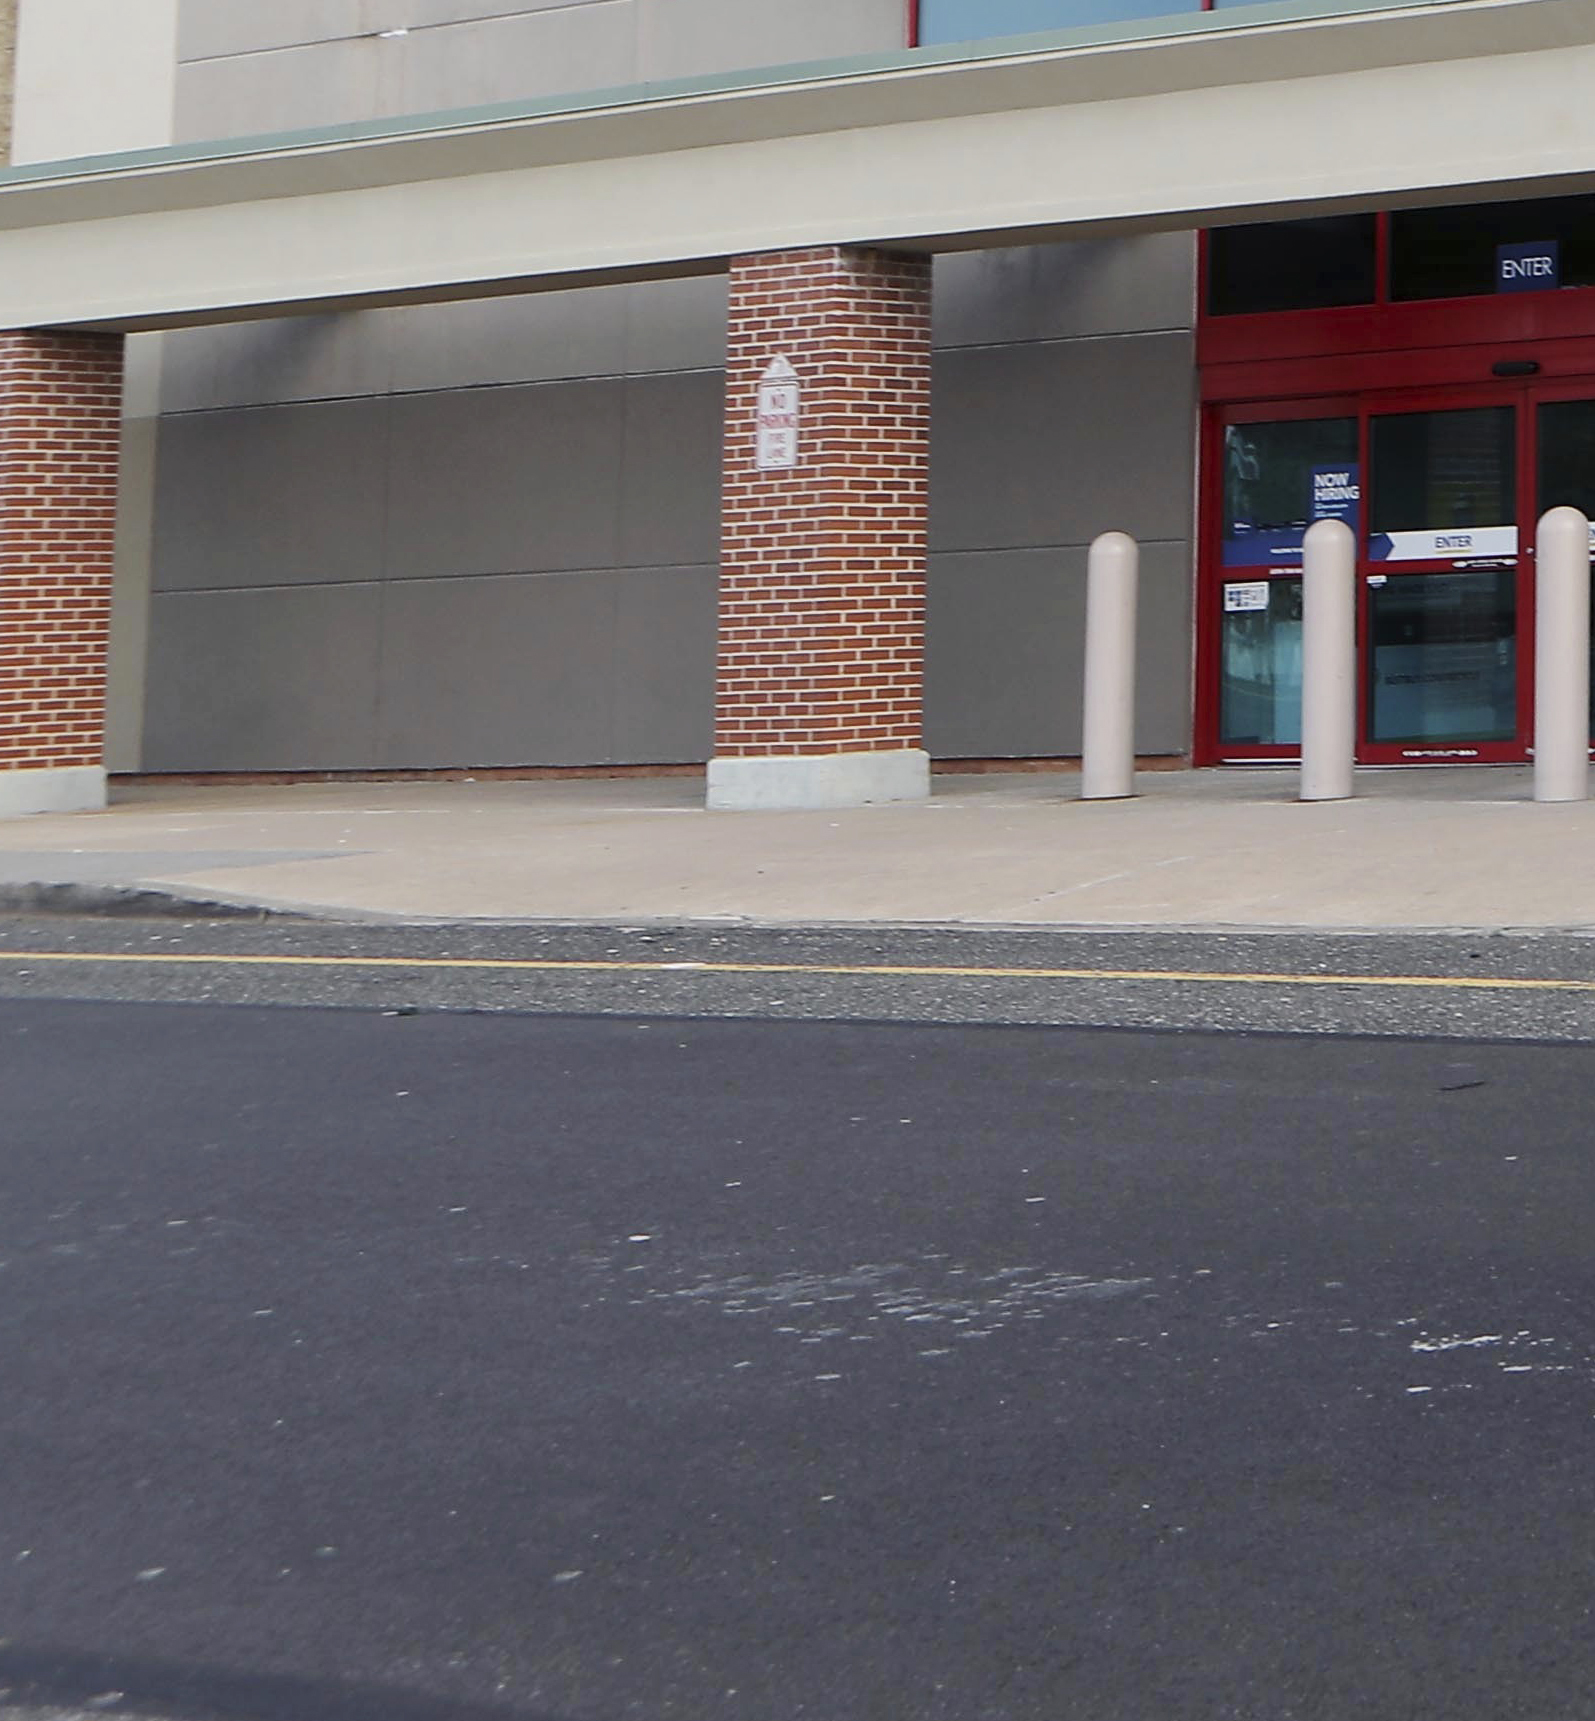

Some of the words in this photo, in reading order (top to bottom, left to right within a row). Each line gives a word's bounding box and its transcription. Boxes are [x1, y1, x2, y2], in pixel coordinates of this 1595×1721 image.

[1501, 255, 1554, 279] ENTER
[1314, 472, 1350, 487] NOW
[1314, 486, 1361, 501] HIRING
[1435, 535, 1472, 549] ENTER
